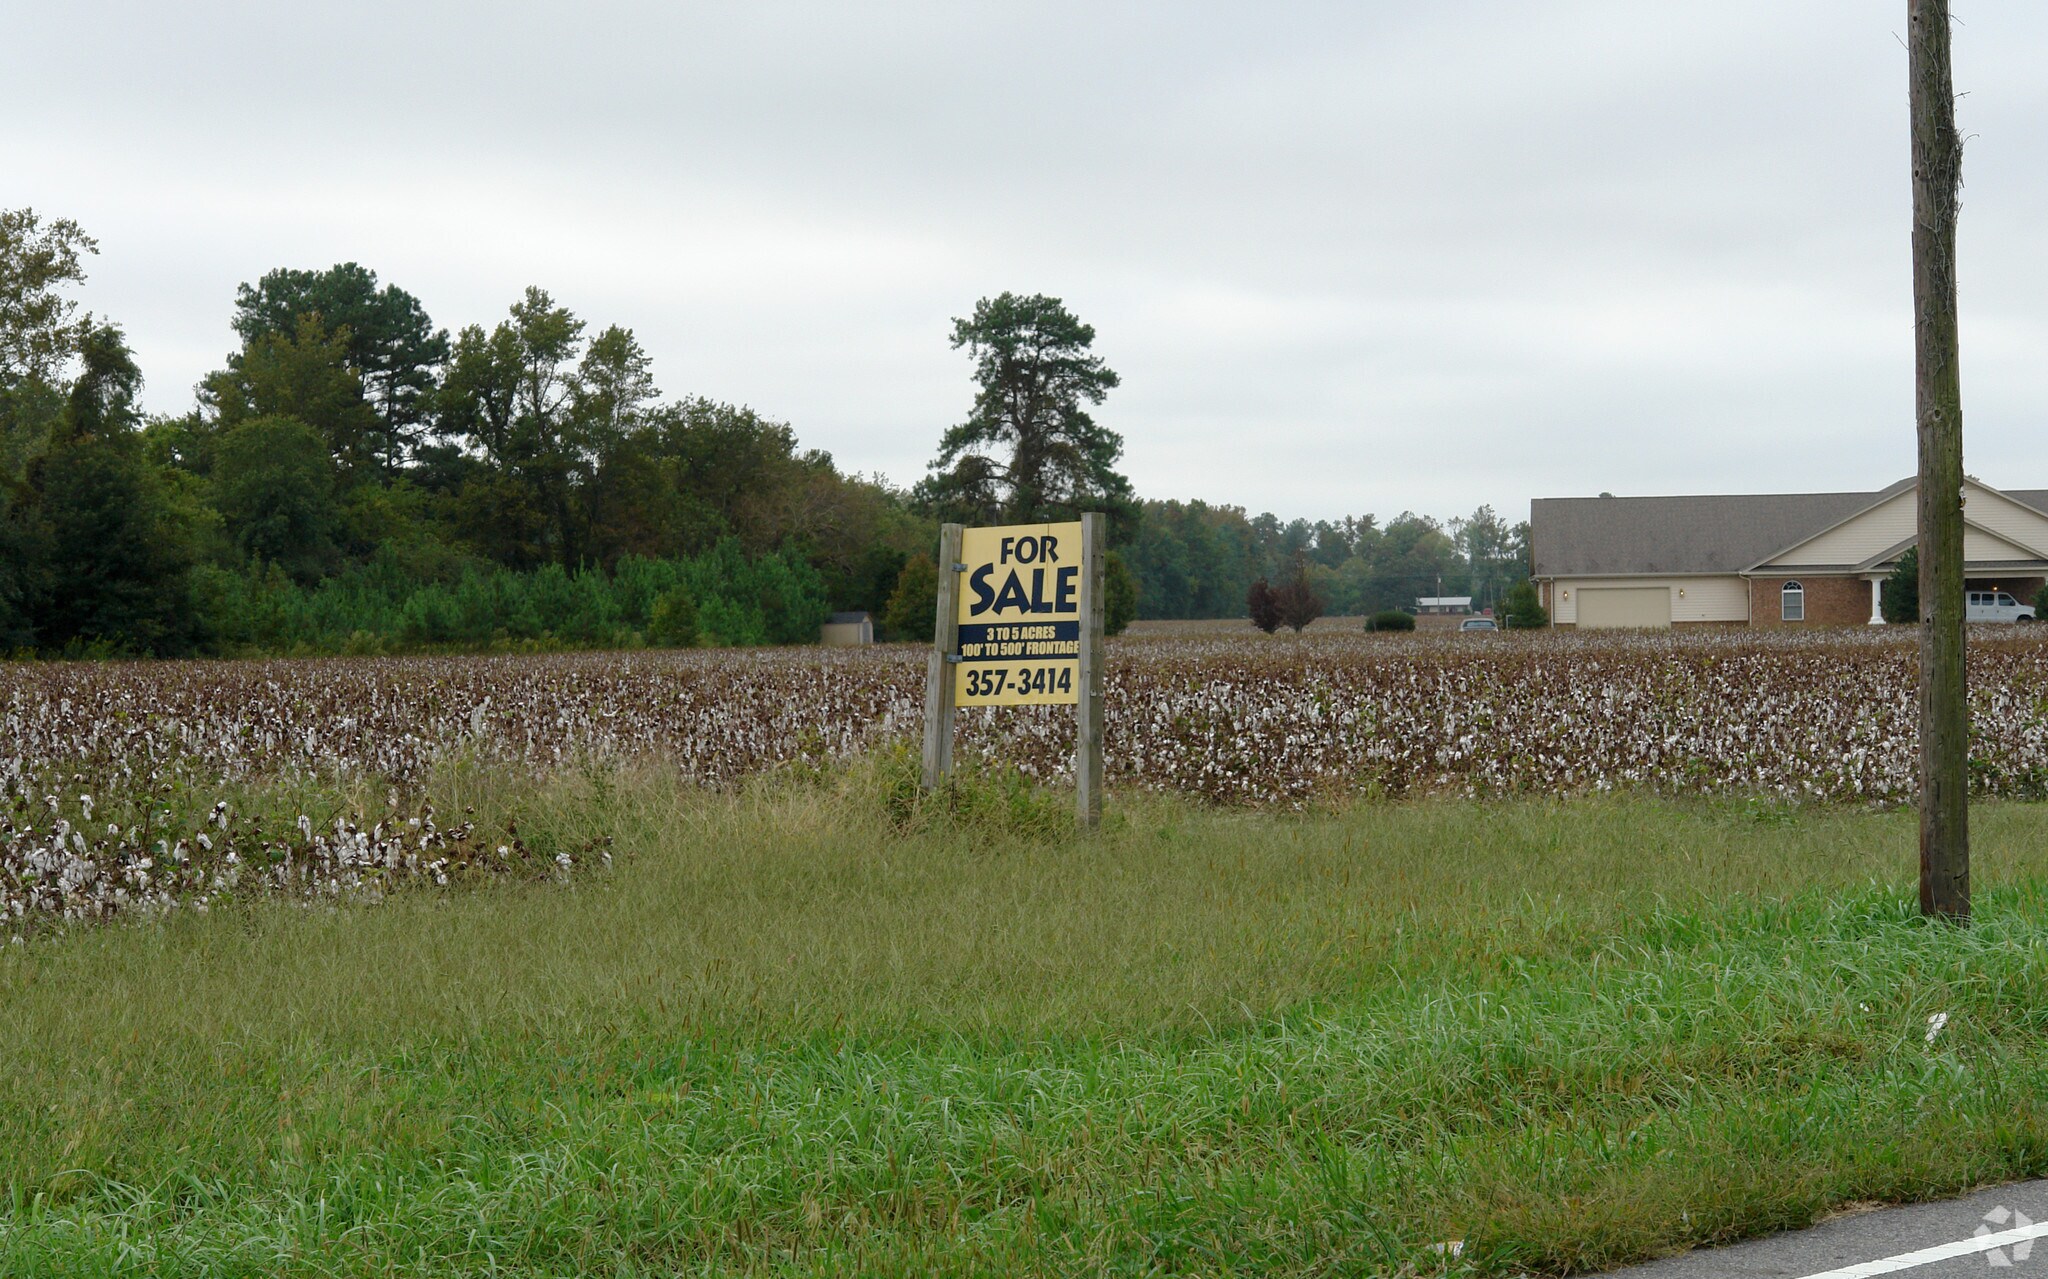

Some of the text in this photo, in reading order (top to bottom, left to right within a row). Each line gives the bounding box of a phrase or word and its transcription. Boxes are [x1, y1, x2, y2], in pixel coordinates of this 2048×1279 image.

[1000, 535, 1059, 564] FOR
[969, 562, 1078, 617] SALE
[986, 625, 1056, 641] 3 TO 5 ACRES
[961, 640, 1080, 657] 100' TO 500' FRONTAGE
[966, 667, 1071, 697] 357-3414
